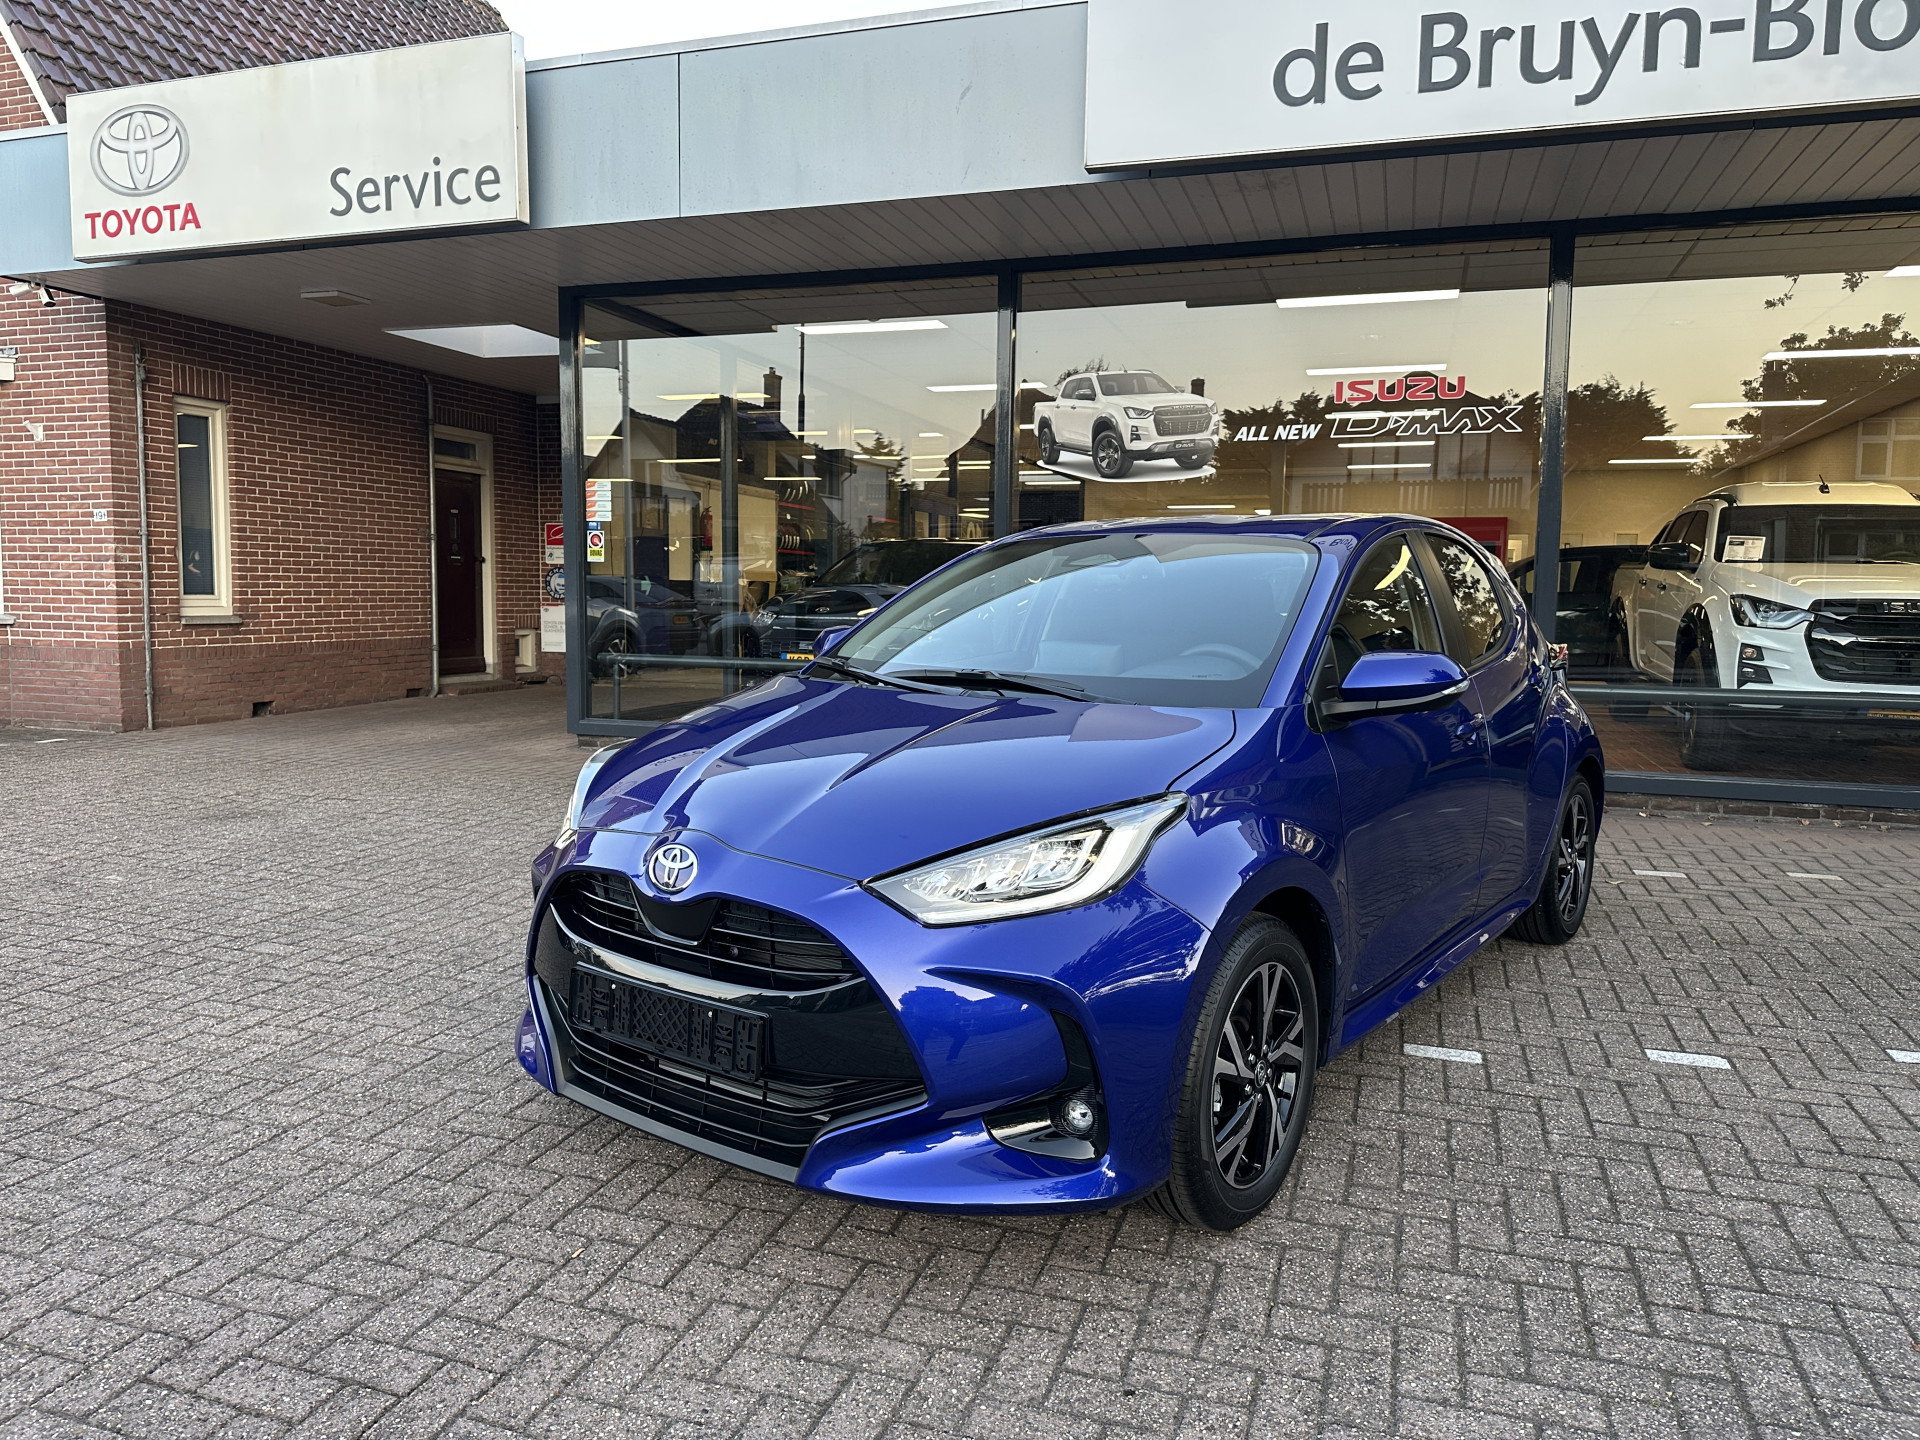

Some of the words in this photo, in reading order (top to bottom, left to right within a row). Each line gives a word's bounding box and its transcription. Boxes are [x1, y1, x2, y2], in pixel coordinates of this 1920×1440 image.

[1273, 22, 1384, 108] de
[330, 157, 501, 217] Service
[85, 202, 201, 240] TOYOTA
[1334, 376, 1466, 404] ISUZU
[1233, 426, 1270, 442] ALL
[1274, 423, 1322, 440] NEW
